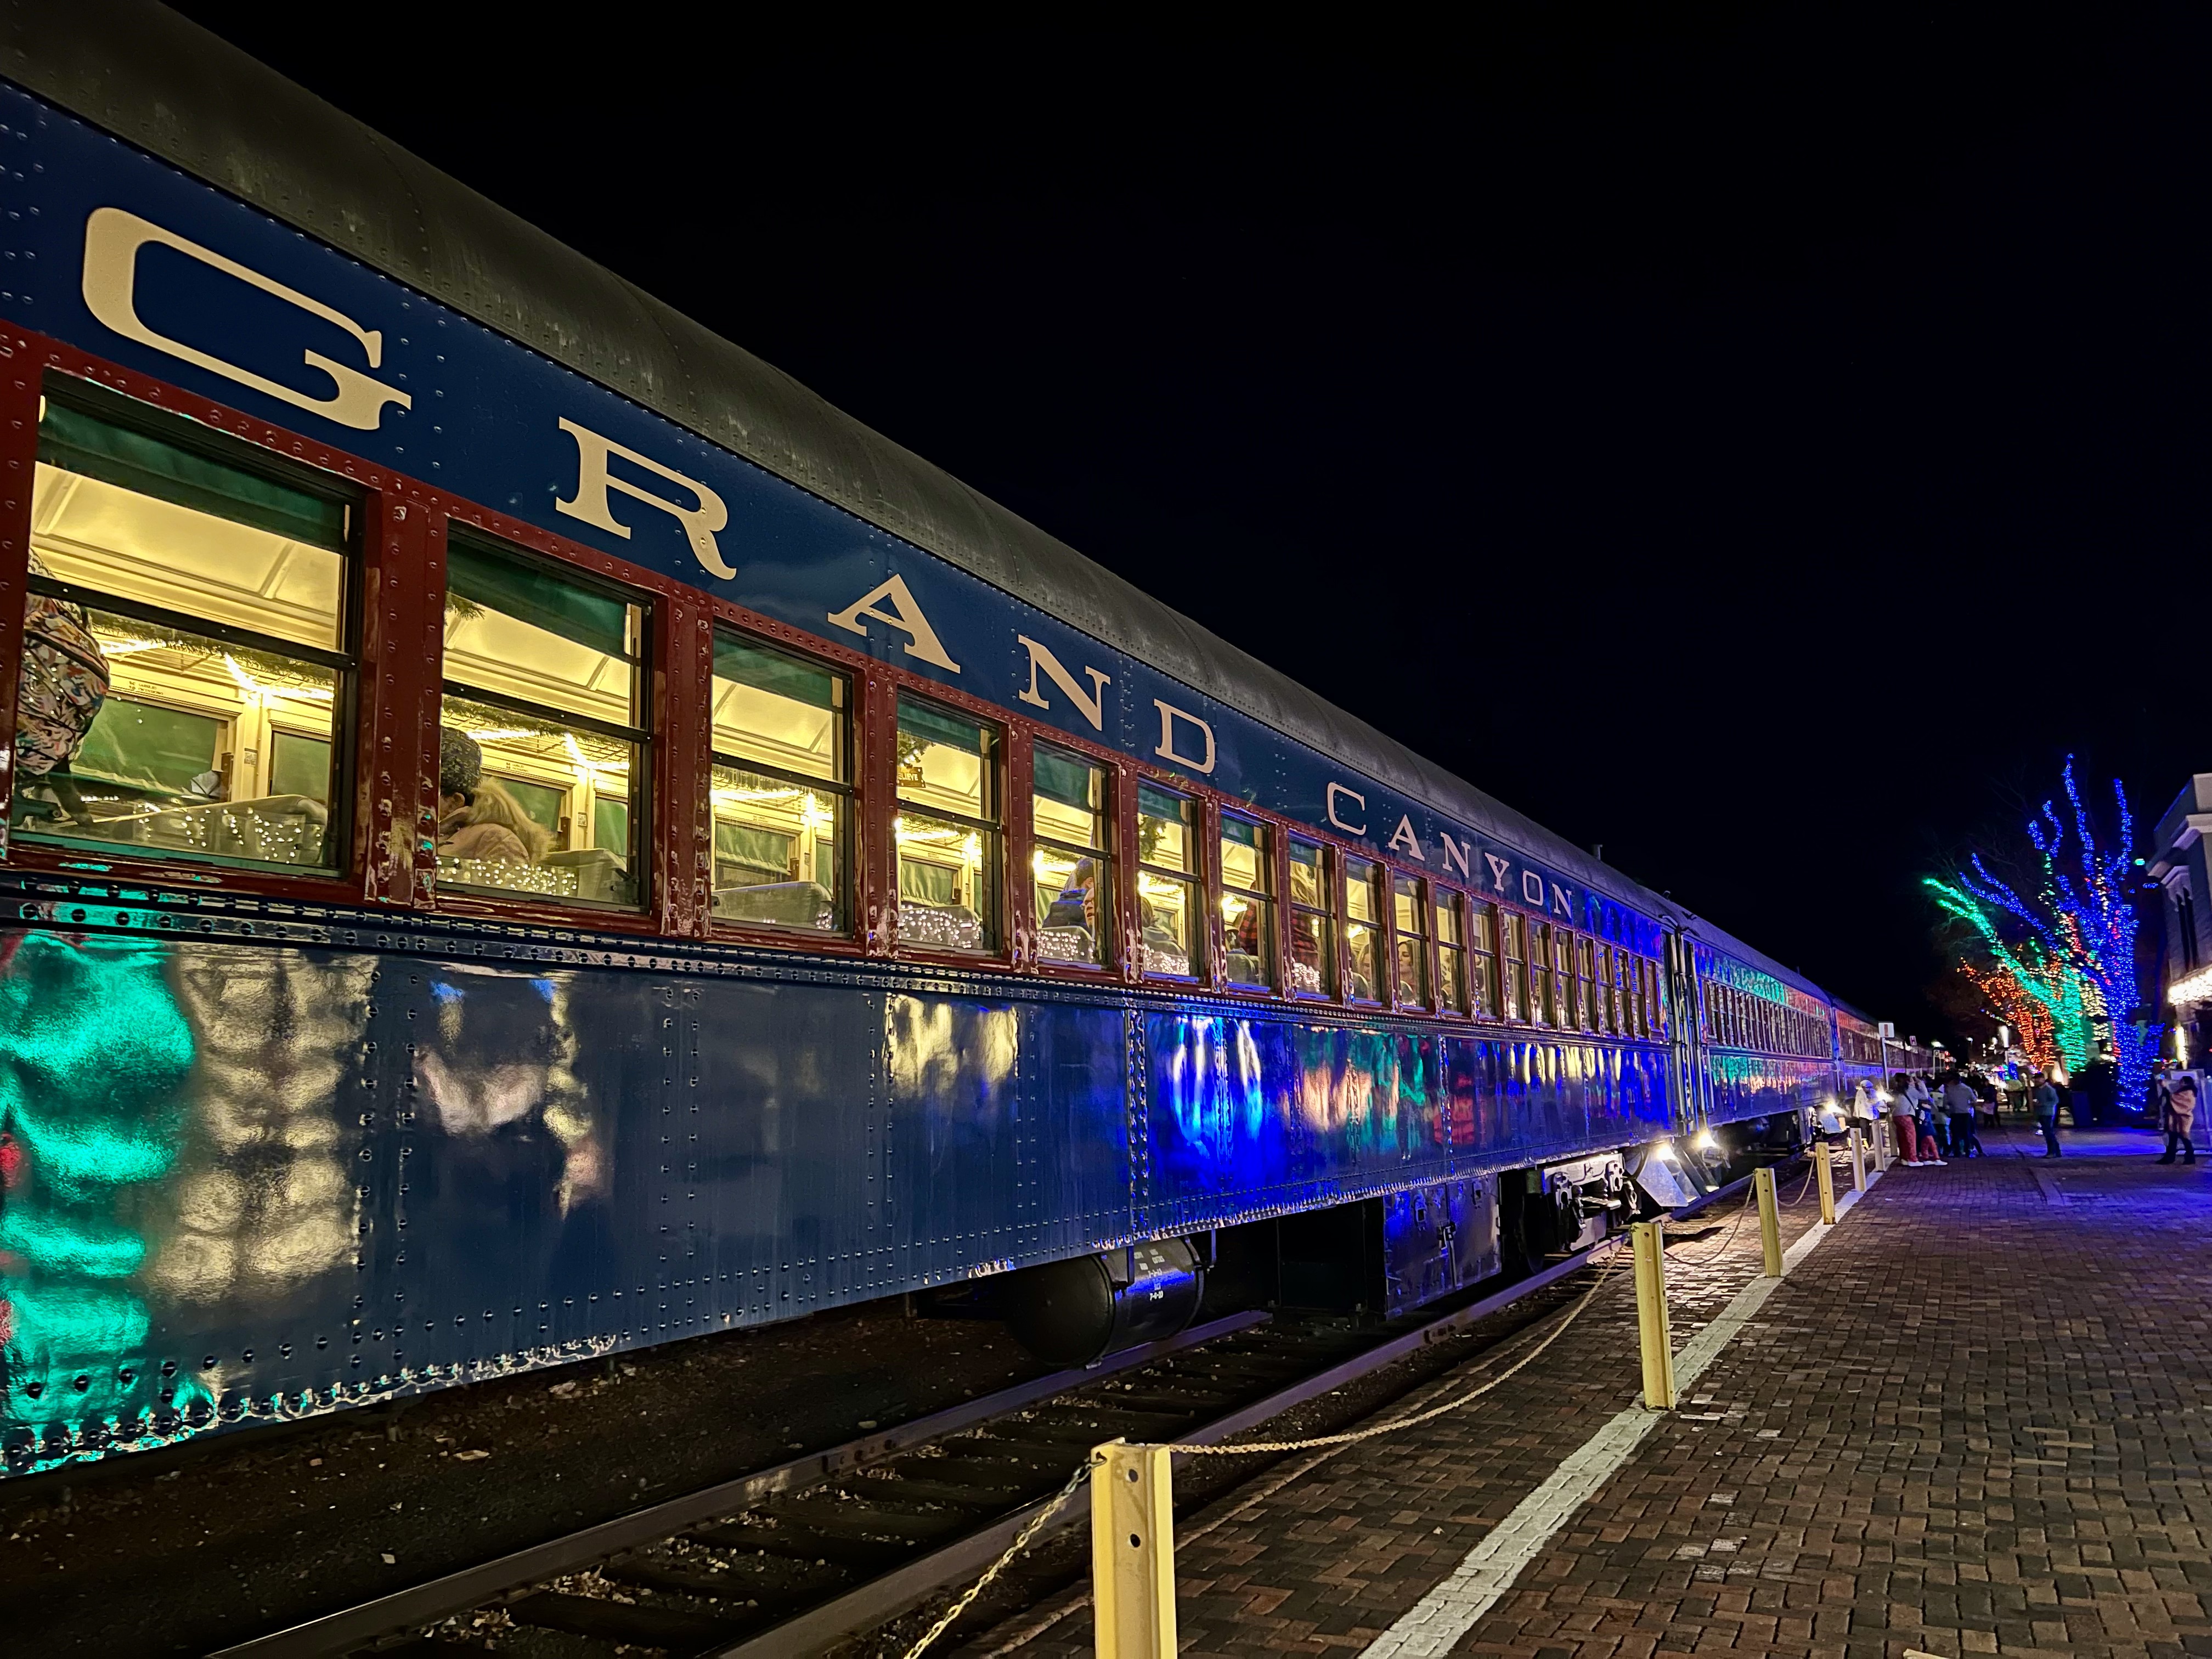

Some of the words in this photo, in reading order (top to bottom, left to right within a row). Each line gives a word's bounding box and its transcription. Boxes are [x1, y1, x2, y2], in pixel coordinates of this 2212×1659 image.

[82, 207, 1216, 774] GRAND
[1327, 781, 1572, 919] CANYON
[898, 772, 919, 781] ELIEVE
